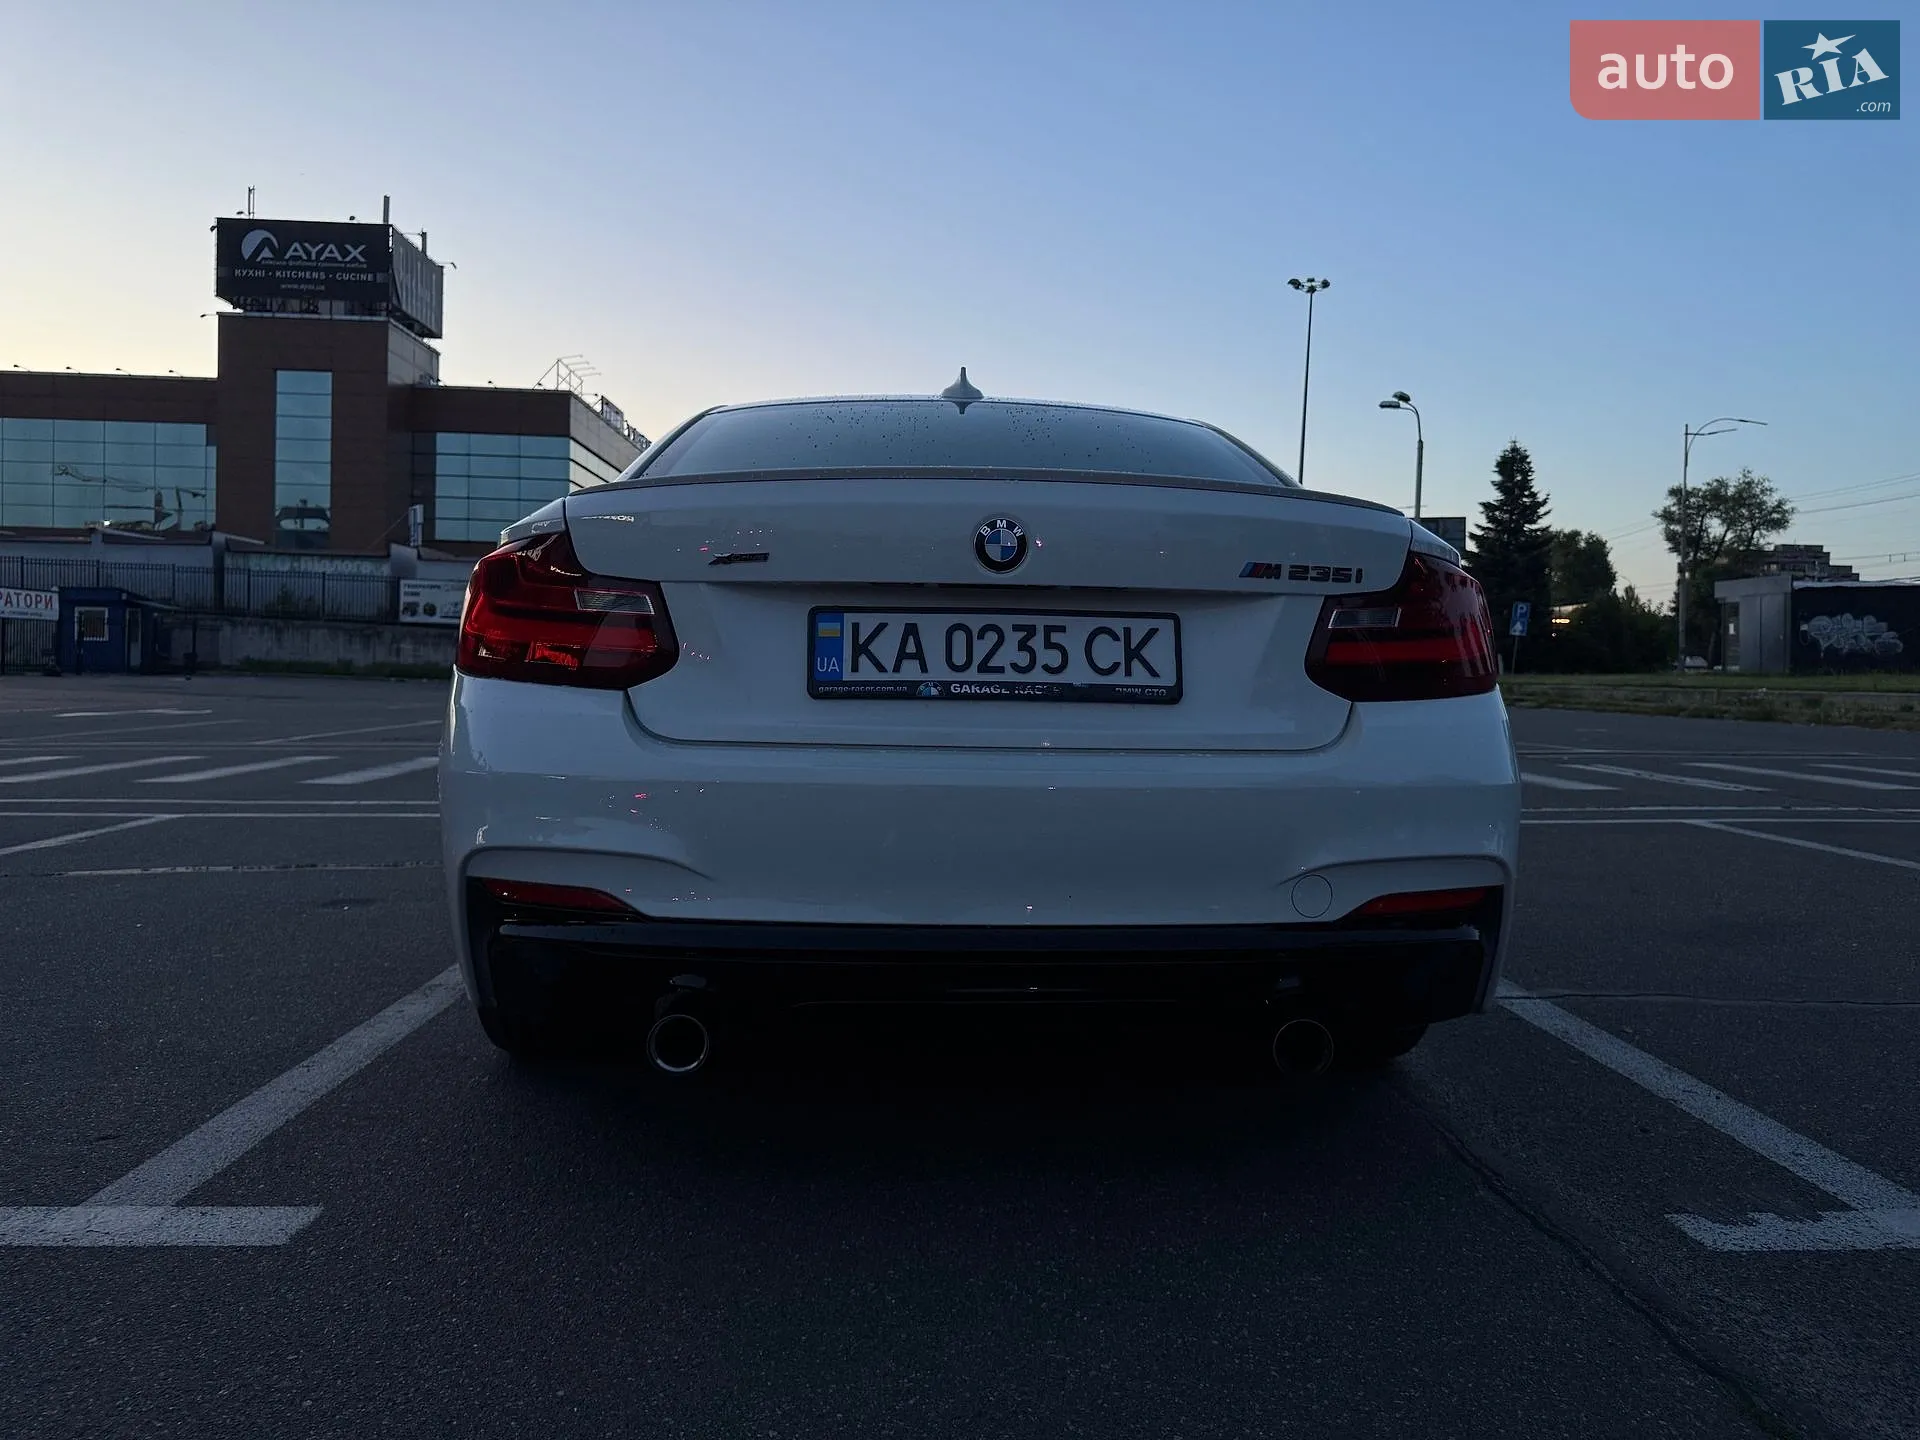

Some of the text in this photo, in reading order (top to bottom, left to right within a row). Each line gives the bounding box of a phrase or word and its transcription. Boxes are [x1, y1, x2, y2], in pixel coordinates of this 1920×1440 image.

[284, 242, 367, 262] AYAX
[275, 270, 326, 280] KITCHENS
[335, 272, 373, 282] CUCINE
[979, 519, 1024, 538] BMW
[1517, 604, 1527, 620] P
[850, 622, 1161, 678] KA 0235 CK
[816, 656, 840, 673] UA
